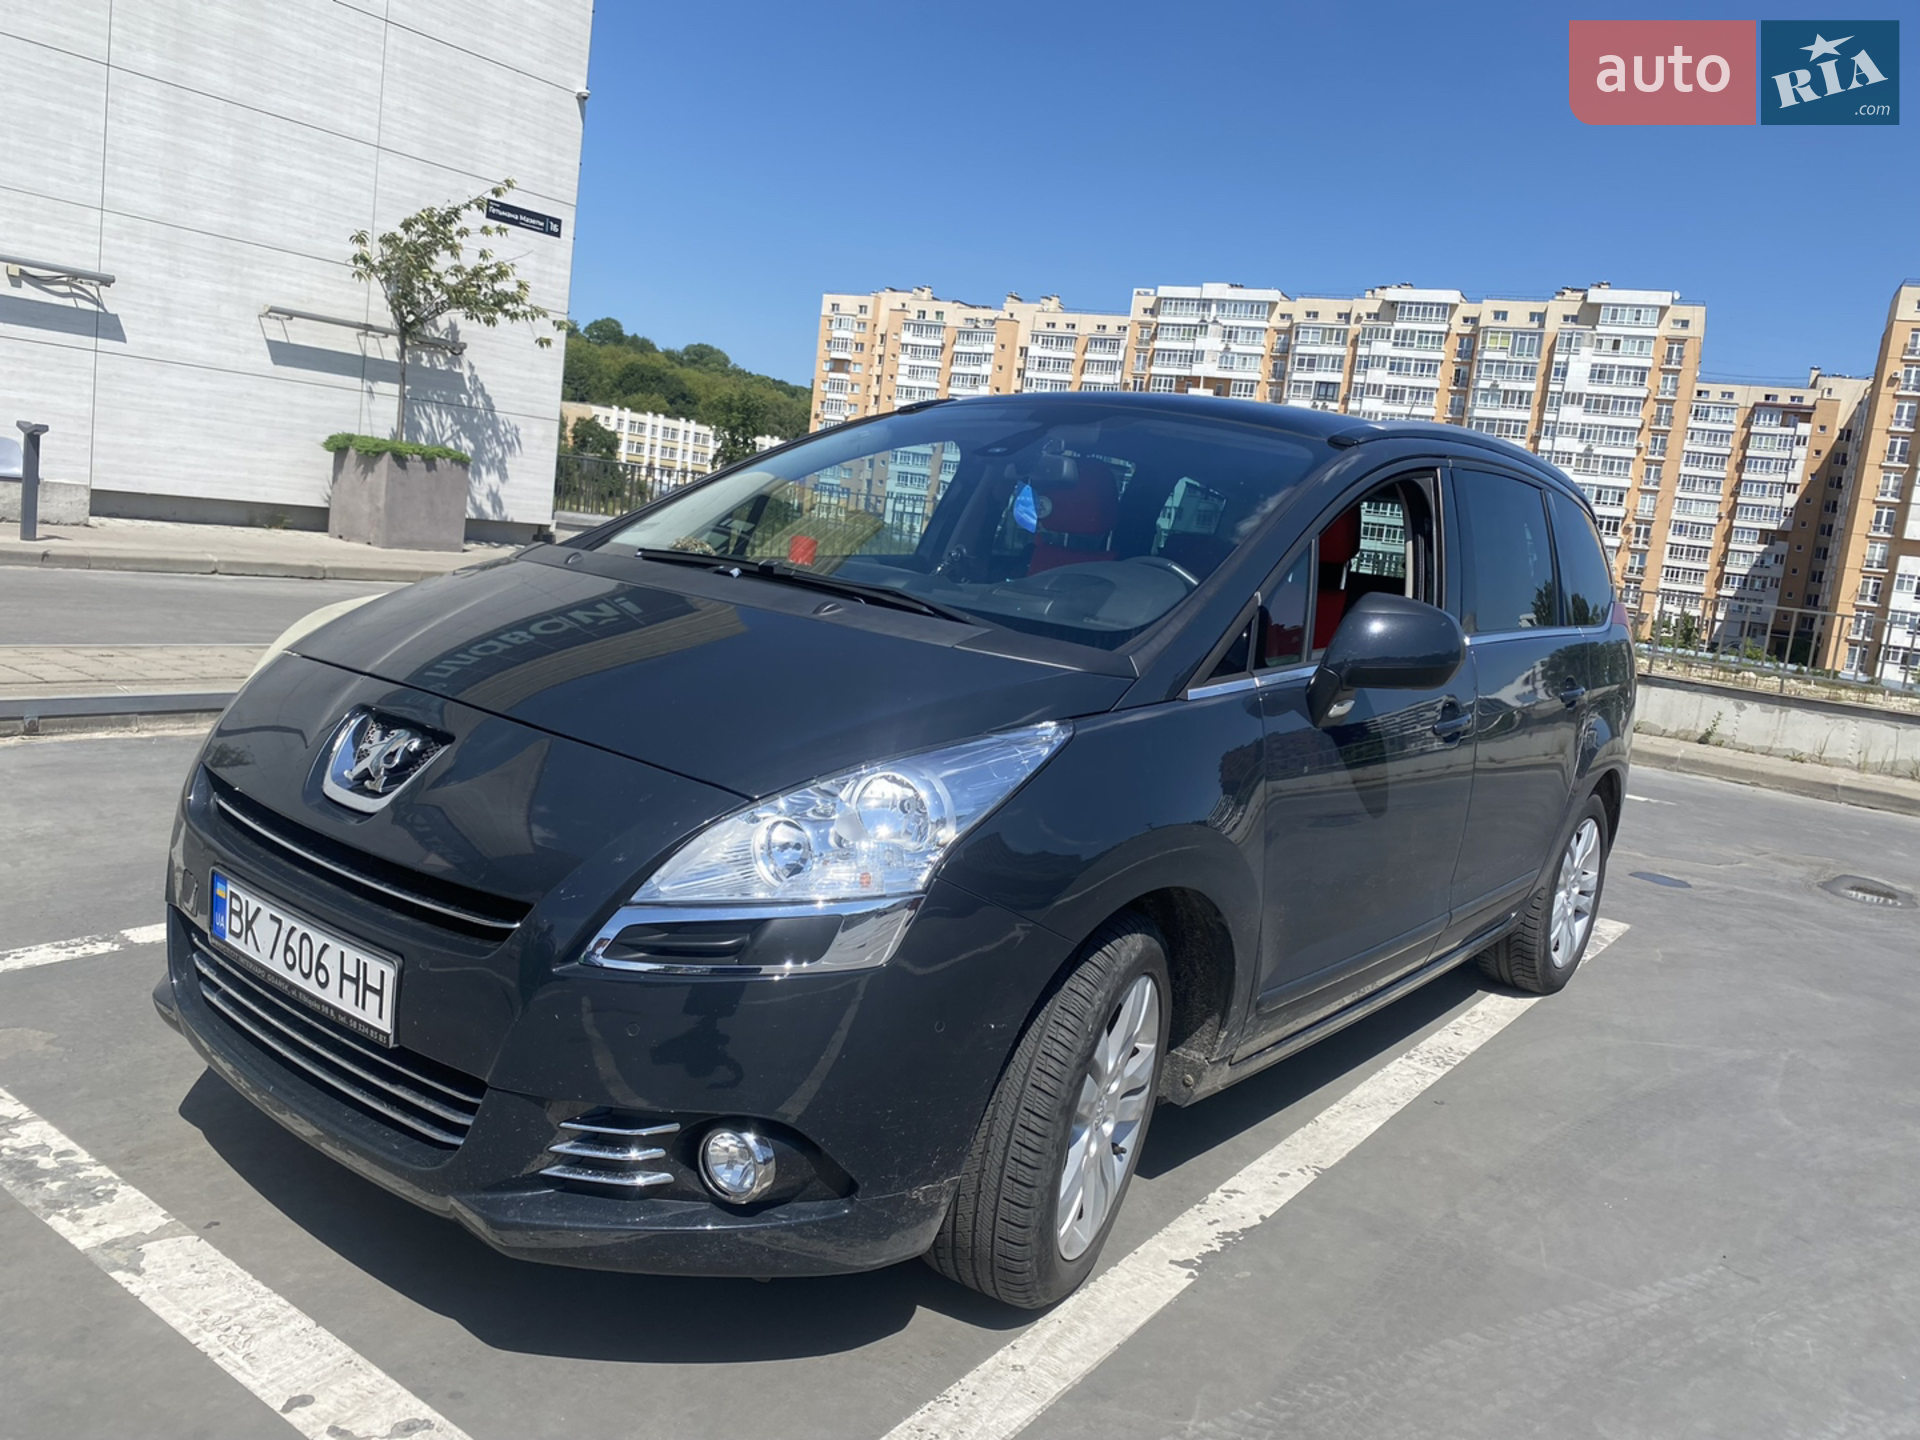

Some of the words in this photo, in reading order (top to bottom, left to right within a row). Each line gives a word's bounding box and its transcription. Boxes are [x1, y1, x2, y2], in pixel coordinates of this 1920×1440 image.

[215, 912, 226, 930] UA
[228, 890, 262, 954] BK
[269, 913, 331, 990] 7606
[338, 949, 385, 1021] HH
